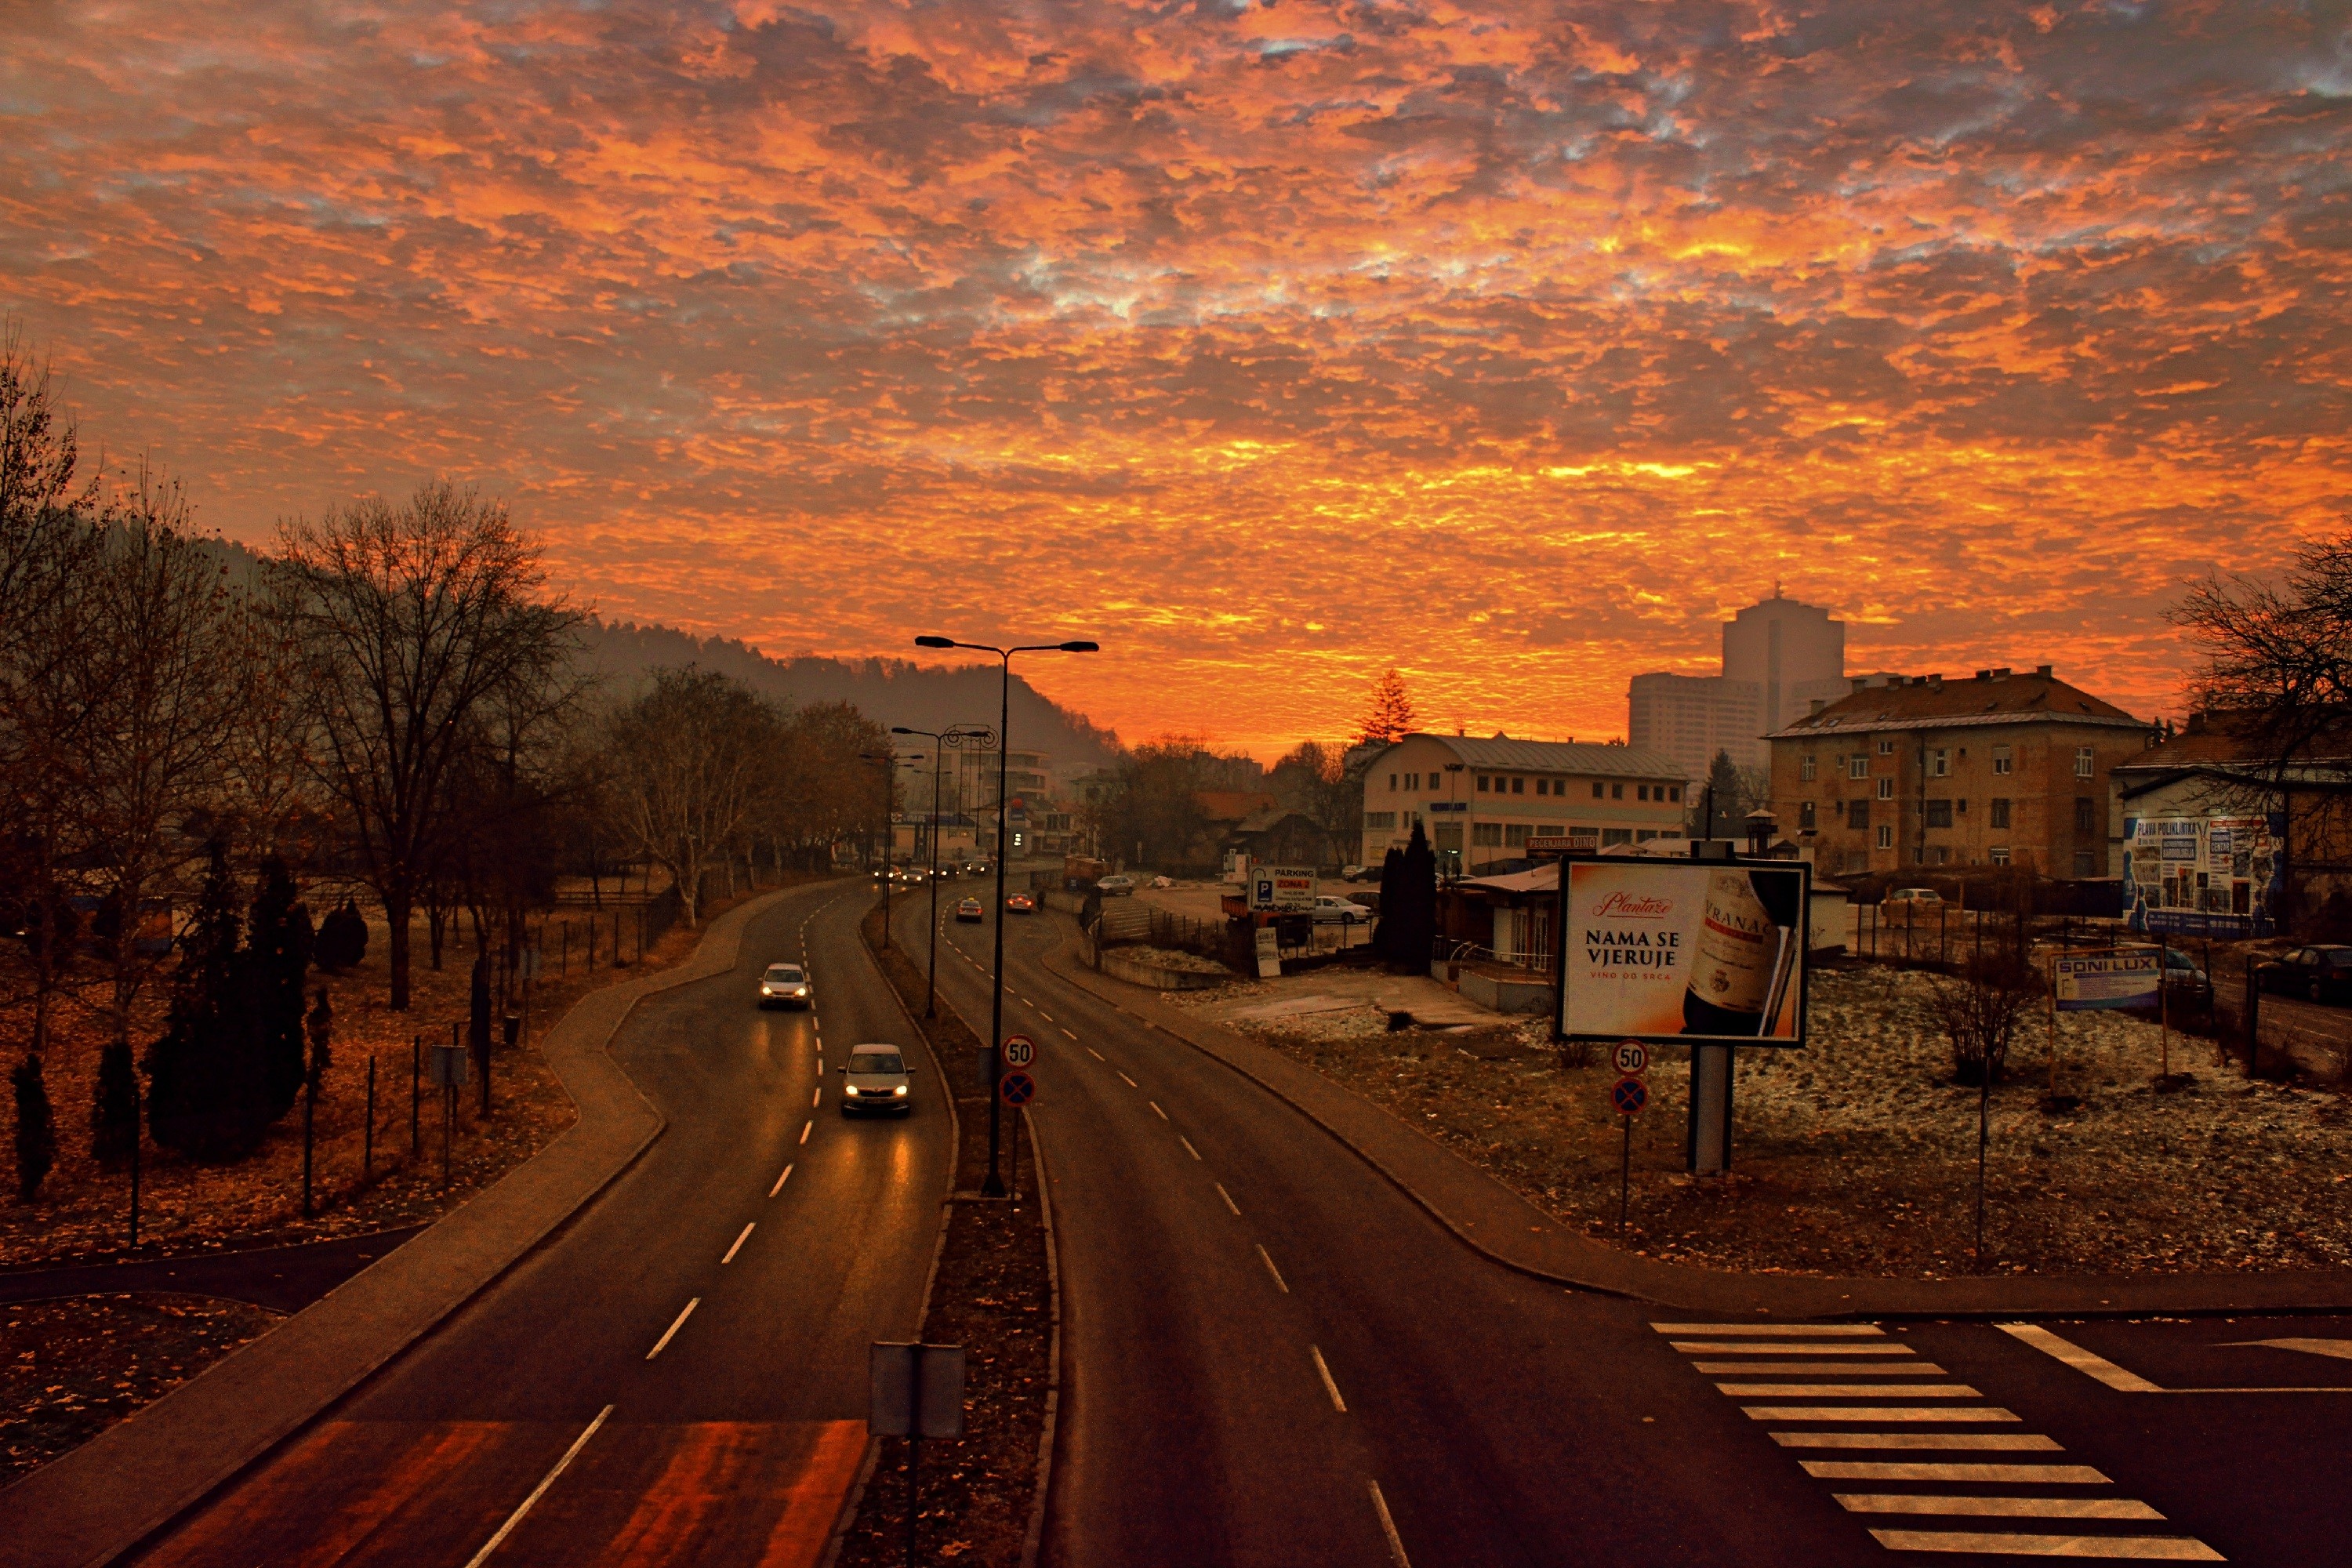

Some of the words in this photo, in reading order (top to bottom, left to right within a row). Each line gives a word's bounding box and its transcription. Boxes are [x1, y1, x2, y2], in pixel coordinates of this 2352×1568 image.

[2138, 822, 2156, 836] PLAVA
[2158, 822, 2196, 836] POLIKLINIKA
[1573, 837, 1595, 848] DINO
[1275, 869, 1314, 877] PARKING
[1261, 883, 1269, 893] P
[1277, 880, 1302, 888] ZONA
[1305, 880, 1310, 888] 2
[1586, 930, 1650, 946] NAMA
[1657, 931, 1679, 946] SE
[1588, 949, 1675, 969] VJERUJE
[1009, 1044, 1029, 1062] 50
[1621, 1049, 1642, 1068] 50
